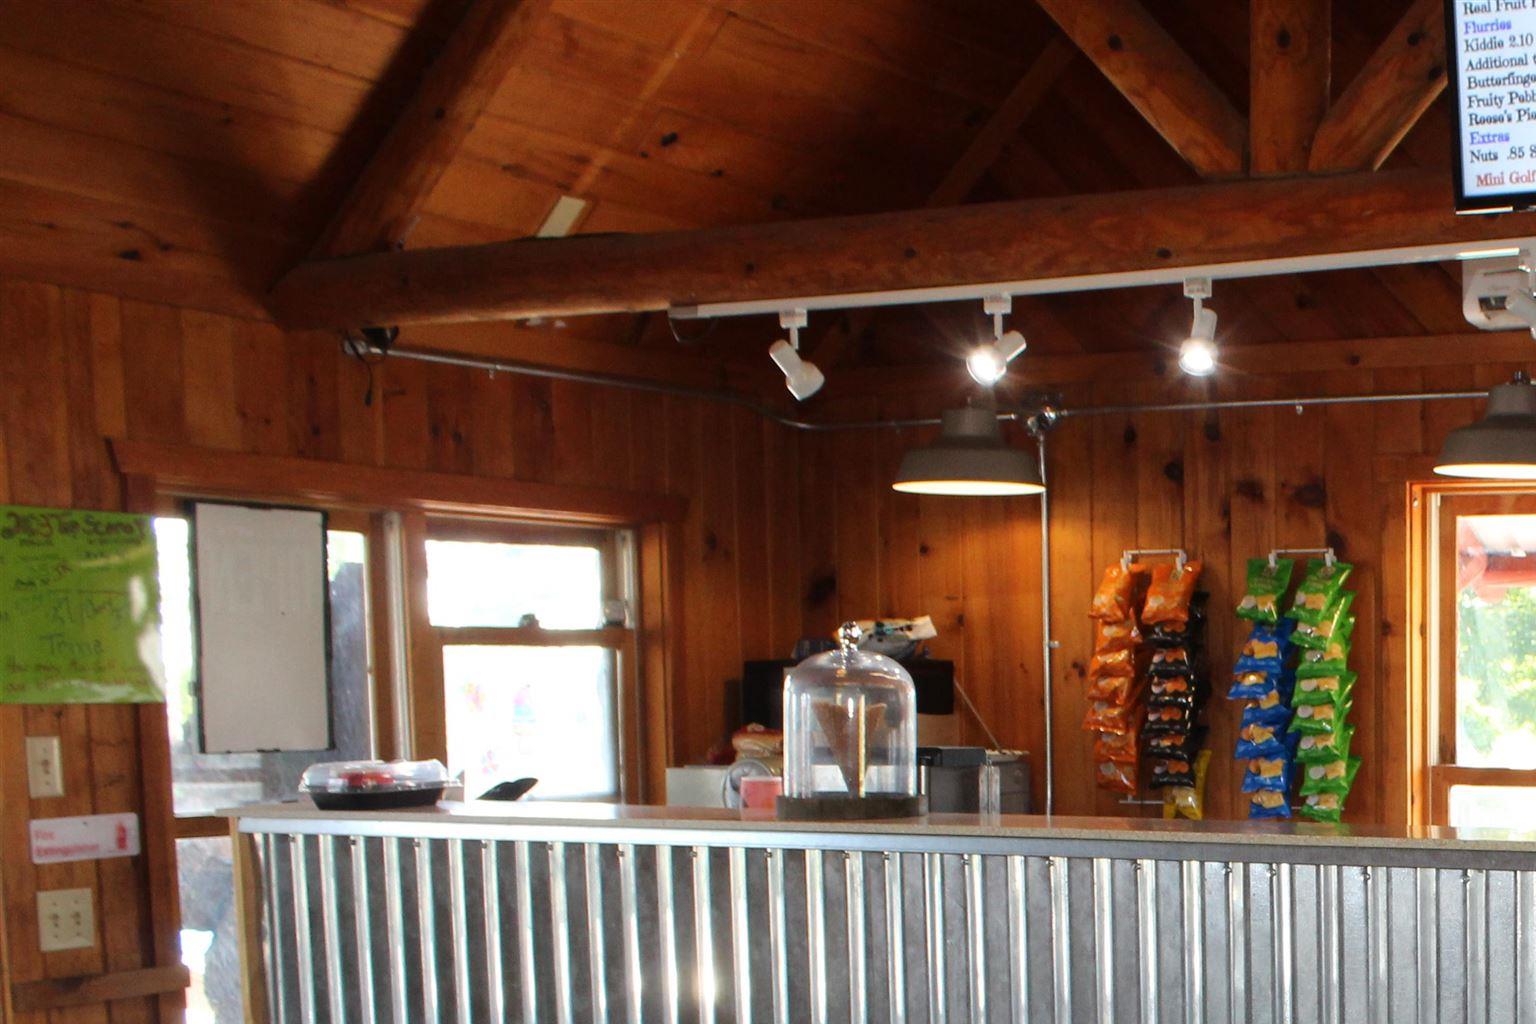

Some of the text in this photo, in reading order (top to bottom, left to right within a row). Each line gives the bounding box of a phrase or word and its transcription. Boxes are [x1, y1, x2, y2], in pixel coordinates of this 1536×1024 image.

[1464, 0, 1491, 15] Real
[1464, 19, 1512, 35] Flurries
[1464, 38, 1504, 53] Kiddie
[1509, 33, 1534, 48] 2.10
[1466, 53, 1528, 72] Additional
[1467, 91, 1504, 110] Fruity
[1469, 108, 1512, 127] Reese's
[1469, 130, 1510, 145] Extras
[1470, 148, 1498, 163] Nuts
[1506, 145, 1525, 160] .85
[1476, 171, 1505, 187] Mini
[1509, 168, 1536, 185] Golf
